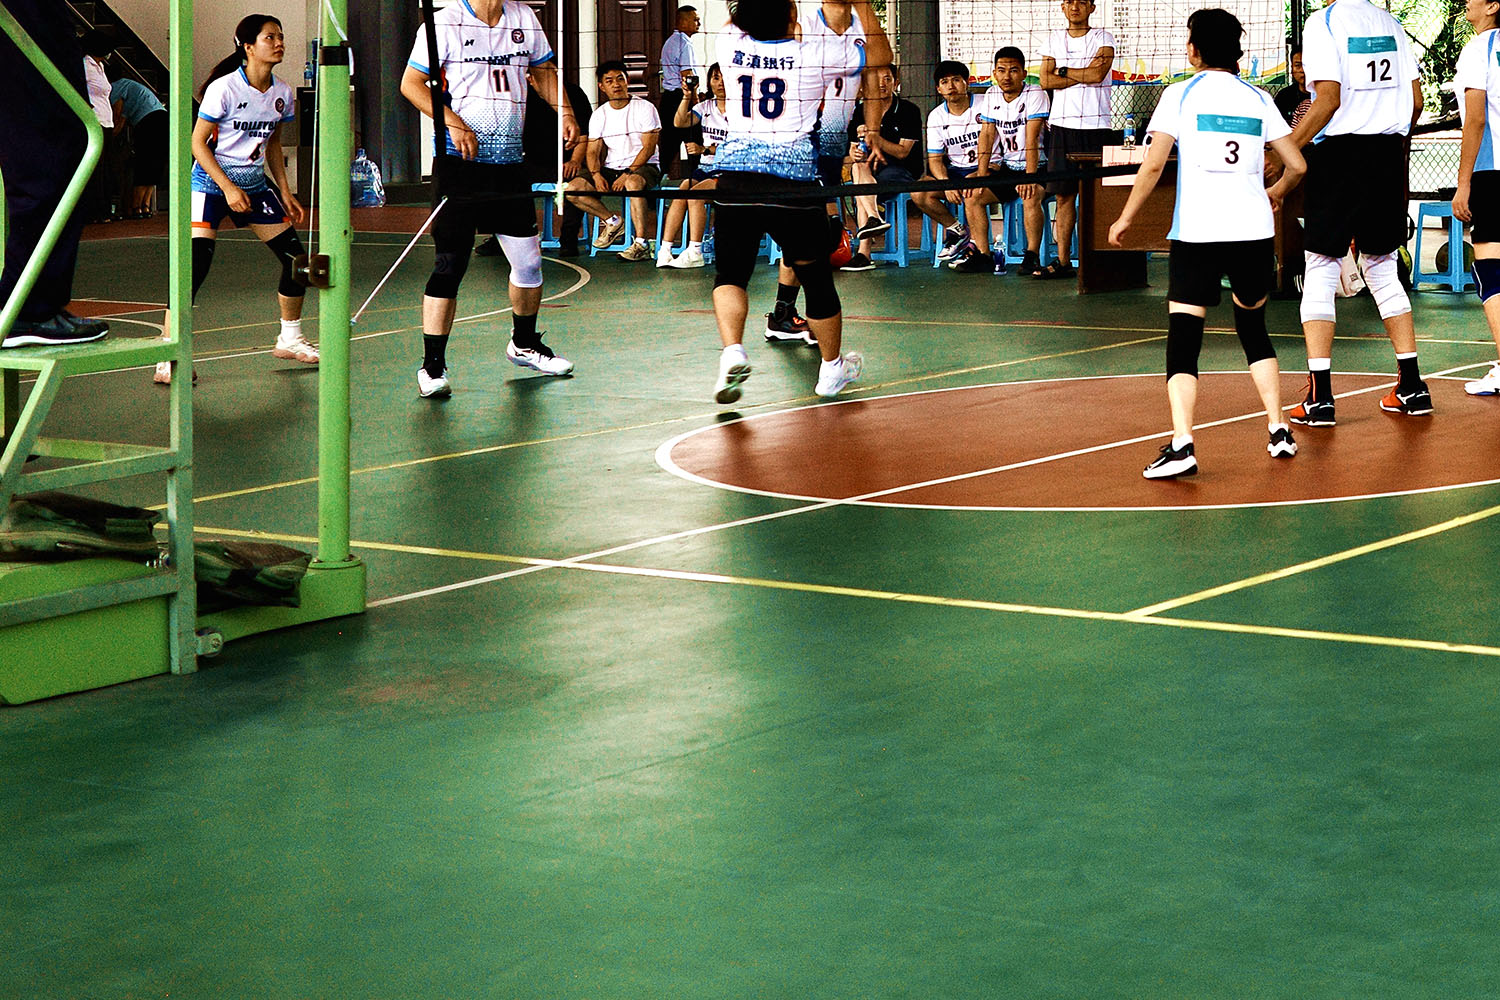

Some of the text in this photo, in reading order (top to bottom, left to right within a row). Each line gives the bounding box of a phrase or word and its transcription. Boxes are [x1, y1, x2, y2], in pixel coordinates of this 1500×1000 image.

[492, 68, 511, 92] 11
[1366, 58, 1392, 82] 12
[737, 74, 788, 120] 18
[835, 78, 843, 97] 9
[1005, 135, 1018, 151] 16
[1224, 140, 1240, 165] 3
[968, 150, 977, 163] 8
